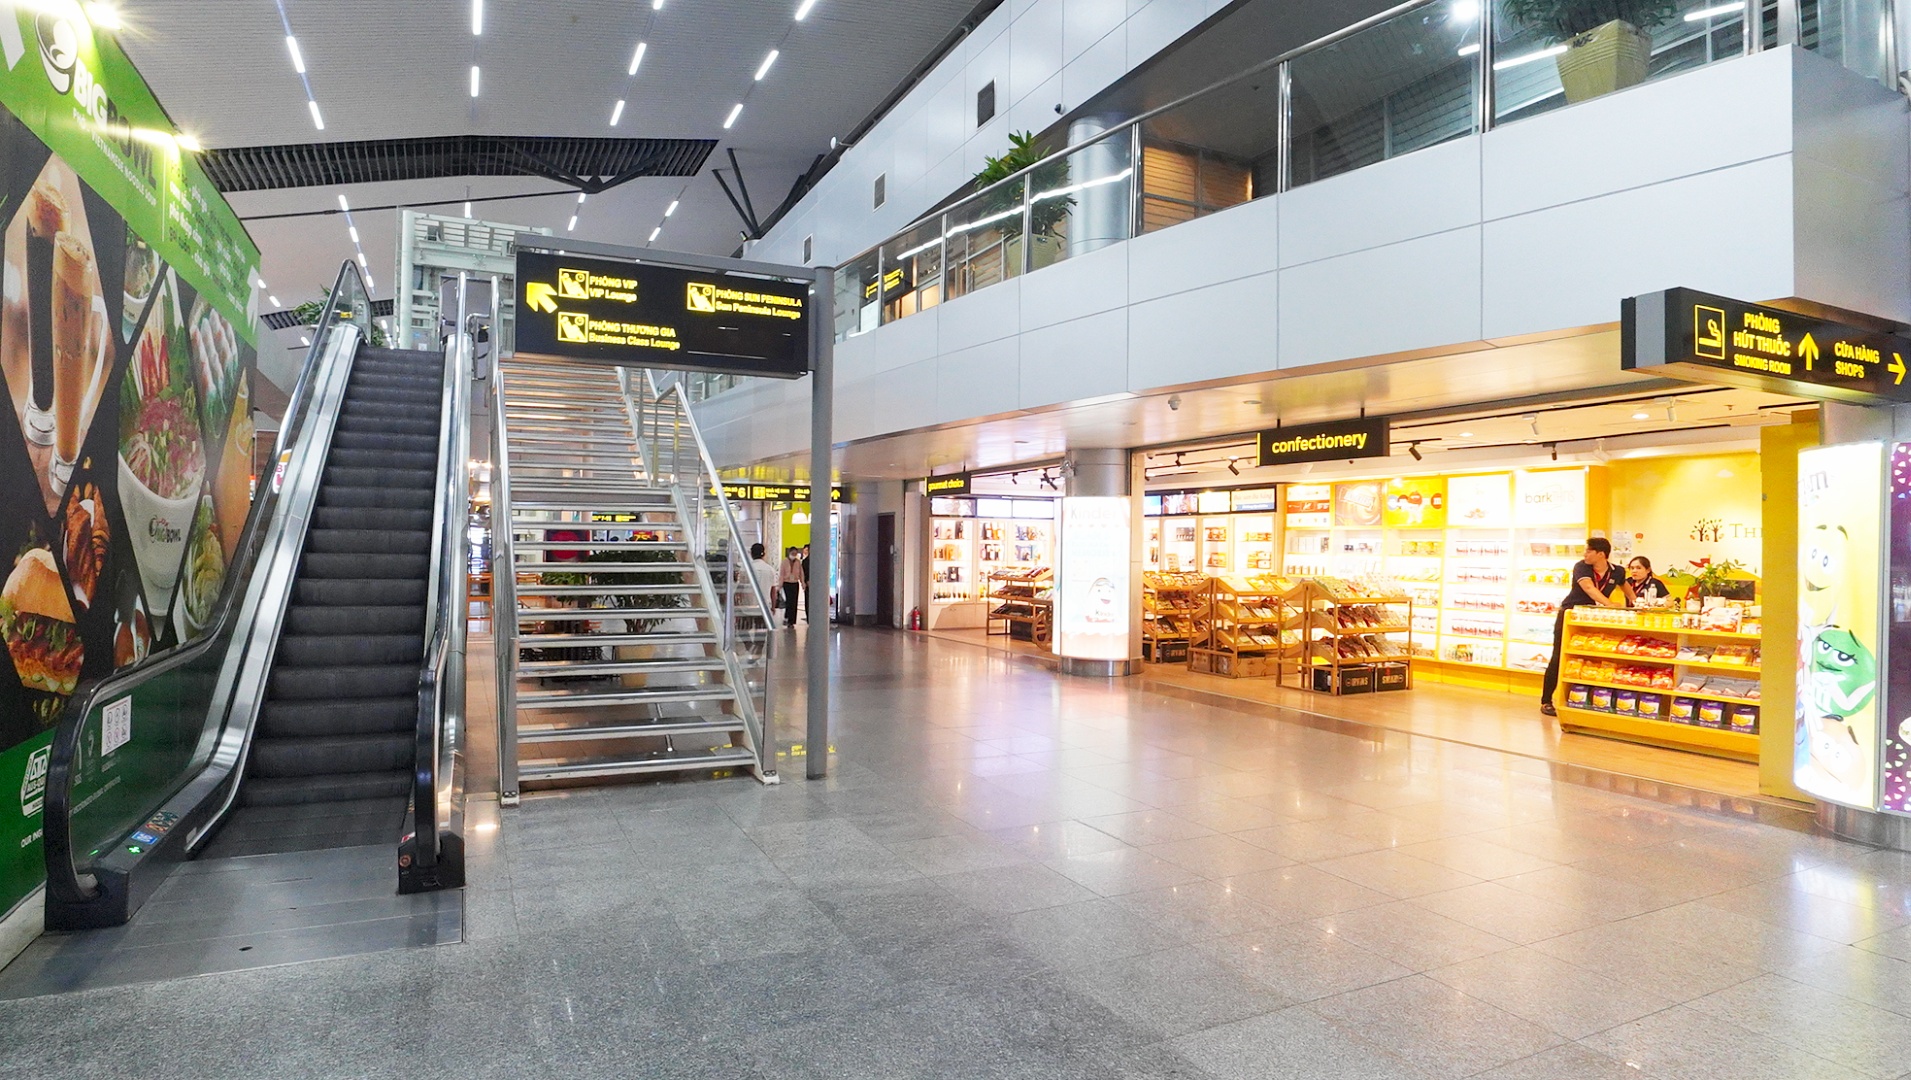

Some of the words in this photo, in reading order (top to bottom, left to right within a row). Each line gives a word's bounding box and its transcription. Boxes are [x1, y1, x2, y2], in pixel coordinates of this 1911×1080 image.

[590, 276, 621, 288] PHÒNG
[622, 279, 637, 289] VIP
[589, 288, 604, 298] VIP
[605, 289, 637, 303] Lounge
[716, 289, 743, 301] PHÒNG
[744, 292, 760, 302] SUN
[761, 294, 802, 307] PENINSULA
[716, 301, 732, 311] Sun
[733, 303, 771, 316] Peninsula
[772, 307, 801, 320] Lounge
[589, 320, 620, 333] PHÒNG
[660, 327, 676, 337] GIA
[1744, 312, 1780, 334] PHÒNG
[588, 332, 626, 344] Business
[627, 335, 649, 346] Class
[650, 338, 680, 351] Lounge
[1734, 330, 1755, 349] HÚT
[1756, 333, 1791, 357] THUỐC
[1835, 341, 1854, 359] CỬA
[1854, 344, 1880, 364] HÀNG
[1734, 354, 1768, 372] SMOKING
[1769, 358, 1791, 375] ROOM
[1835, 363, 1864, 379] SHOPS
[1272, 432, 1367, 454] confectionery
